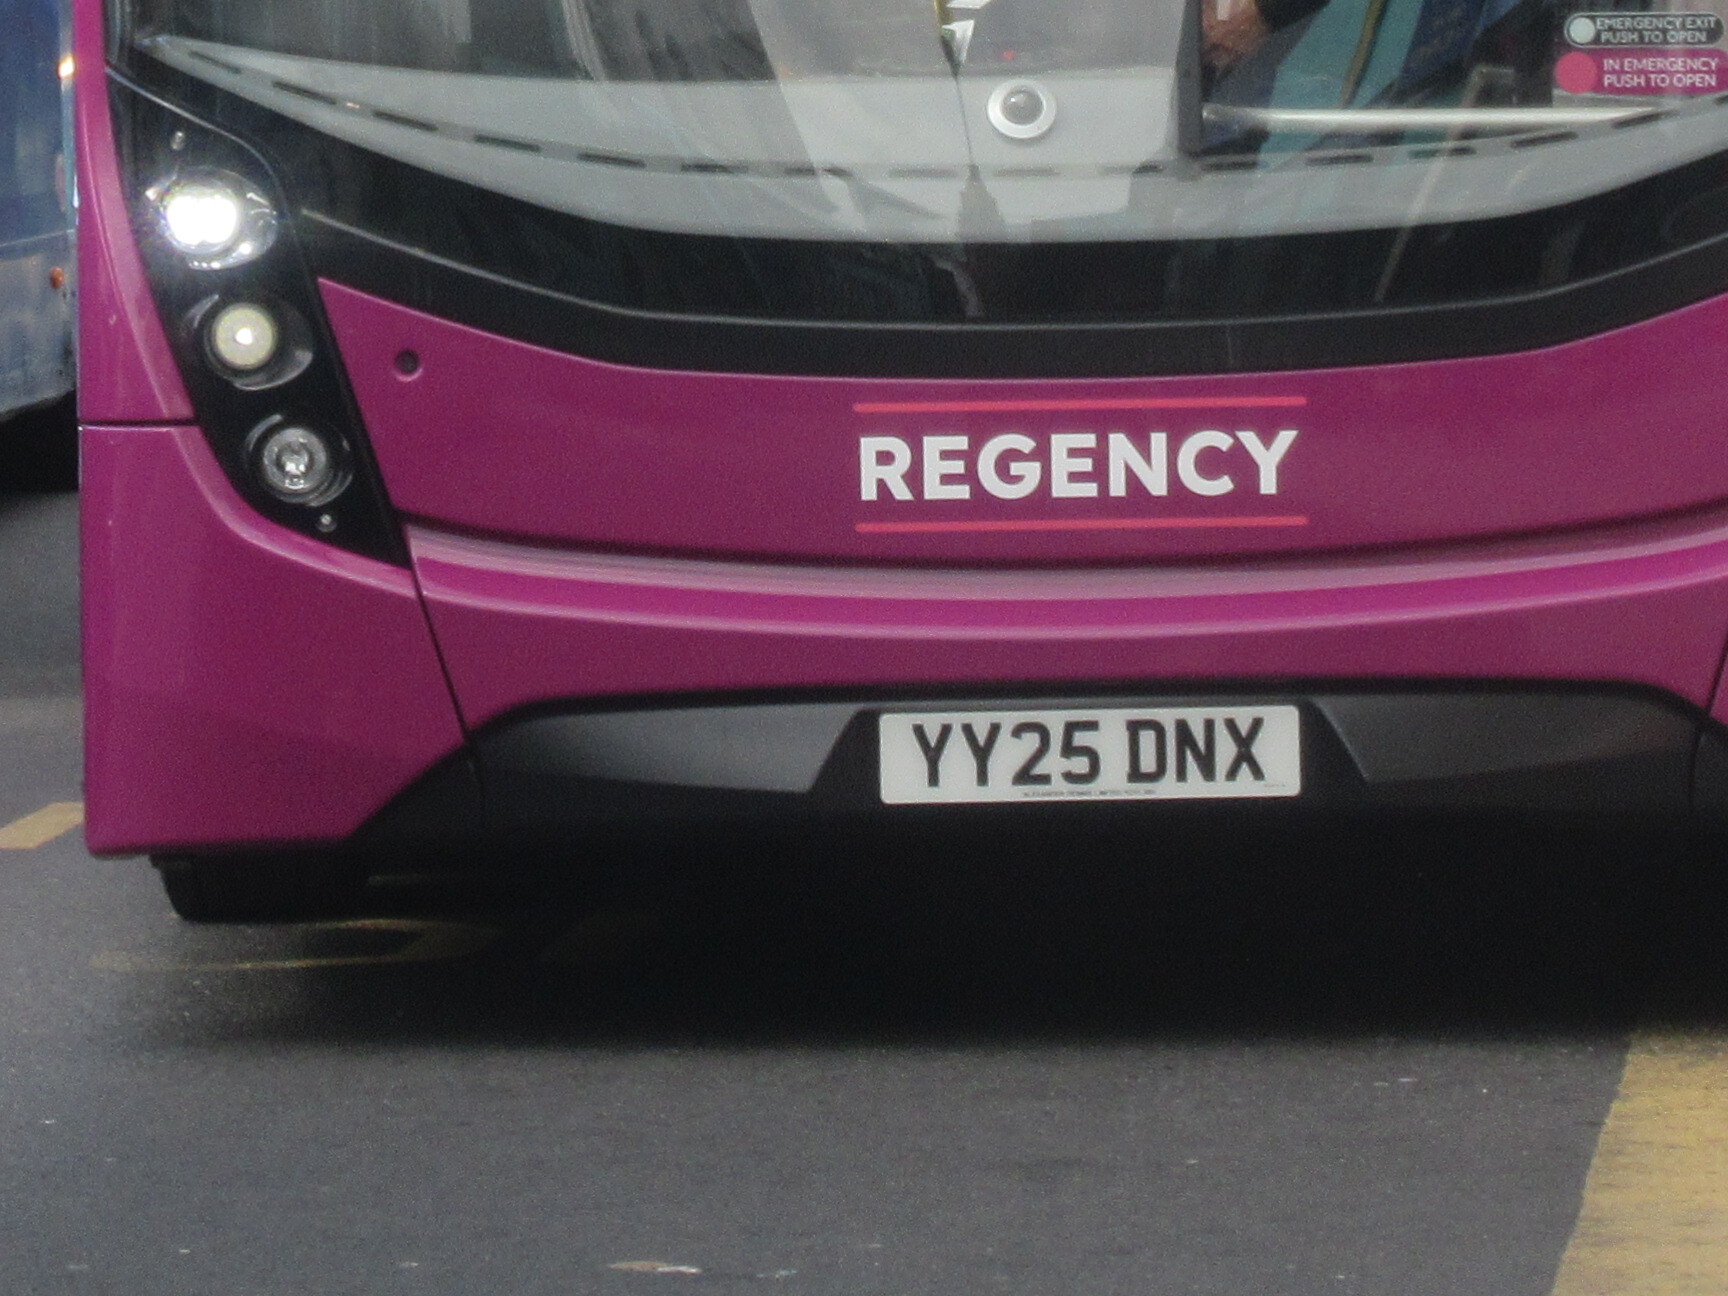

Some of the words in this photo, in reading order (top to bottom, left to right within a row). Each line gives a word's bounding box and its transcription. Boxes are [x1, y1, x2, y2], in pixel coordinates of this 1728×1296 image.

[1595, 17, 1683, 30] EMERGENCY
[1686, 16, 1717, 29] EXIT
[1600, 30, 1639, 43] PUSH
[1643, 30, 1663, 43] TO
[1666, 30, 1707, 42] OPEN
[1603, 58, 1621, 71] IN
[1624, 57, 1719, 71] EMERGENCY
[1603, 74, 1646, 88] PUSH
[1649, 74, 1670, 87] TO
[1673, 73, 1717, 87] OPEN
[858, 429, 1300, 503] REGENCY
[911, 719, 1102, 788] YY25
[1124, 716, 1266, 785] DNX
